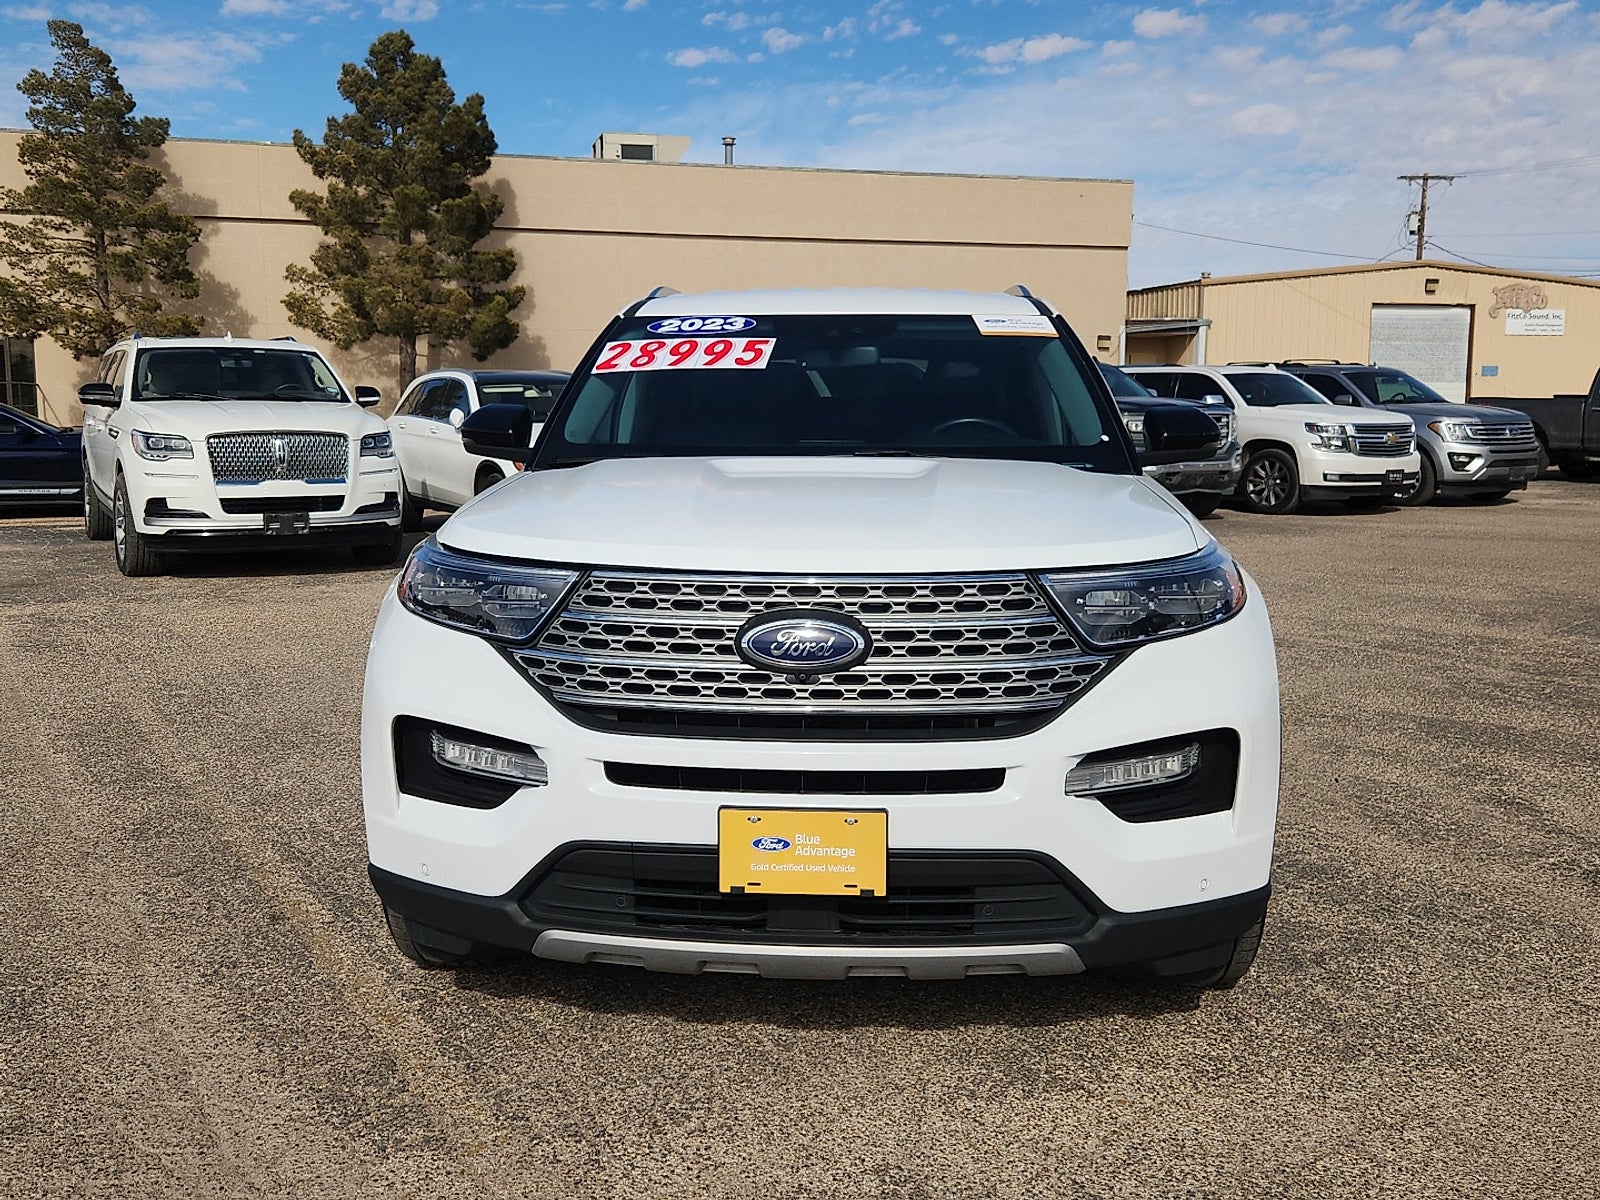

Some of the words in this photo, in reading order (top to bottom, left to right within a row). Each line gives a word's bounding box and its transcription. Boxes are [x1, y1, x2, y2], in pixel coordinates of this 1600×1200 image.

[656, 317, 745, 333] 2023
[595, 339, 770, 371] 28995
[770, 629, 836, 657] Ford
[758, 838, 785, 850] Ford
[795, 834, 821, 845] Blue
[794, 845, 856, 858] Advantage
[751, 863, 769, 872] Gold
[771, 863, 804, 872] Certified
[806, 864, 826, 872] Used
[827, 864, 856, 873] Vehicle
